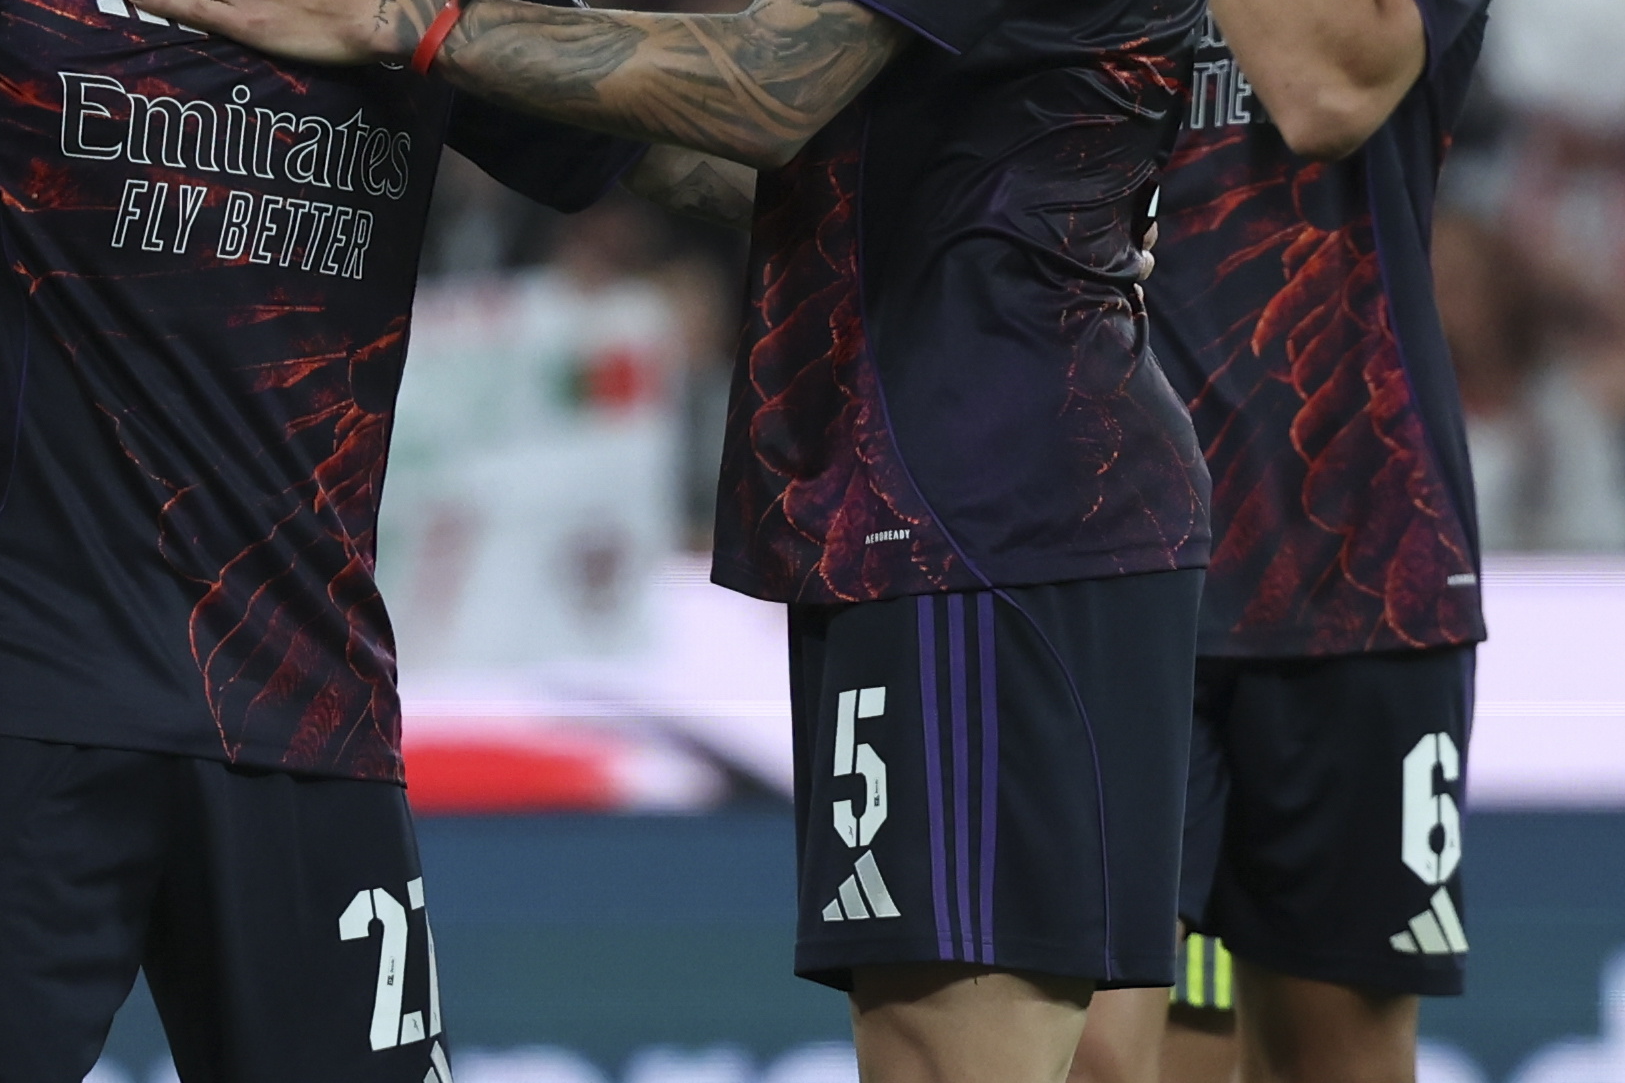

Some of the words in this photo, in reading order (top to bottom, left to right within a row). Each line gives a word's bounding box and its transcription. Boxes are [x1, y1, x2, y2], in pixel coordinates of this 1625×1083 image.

[57, 71, 411, 200] Emirates
[111, 179, 207, 254] FLY
[216, 190, 374, 279] BETTER
[864, 528, 911, 545] AEROREADY
[832, 686, 888, 848] 5
[1401, 732, 1462, 886] 6
